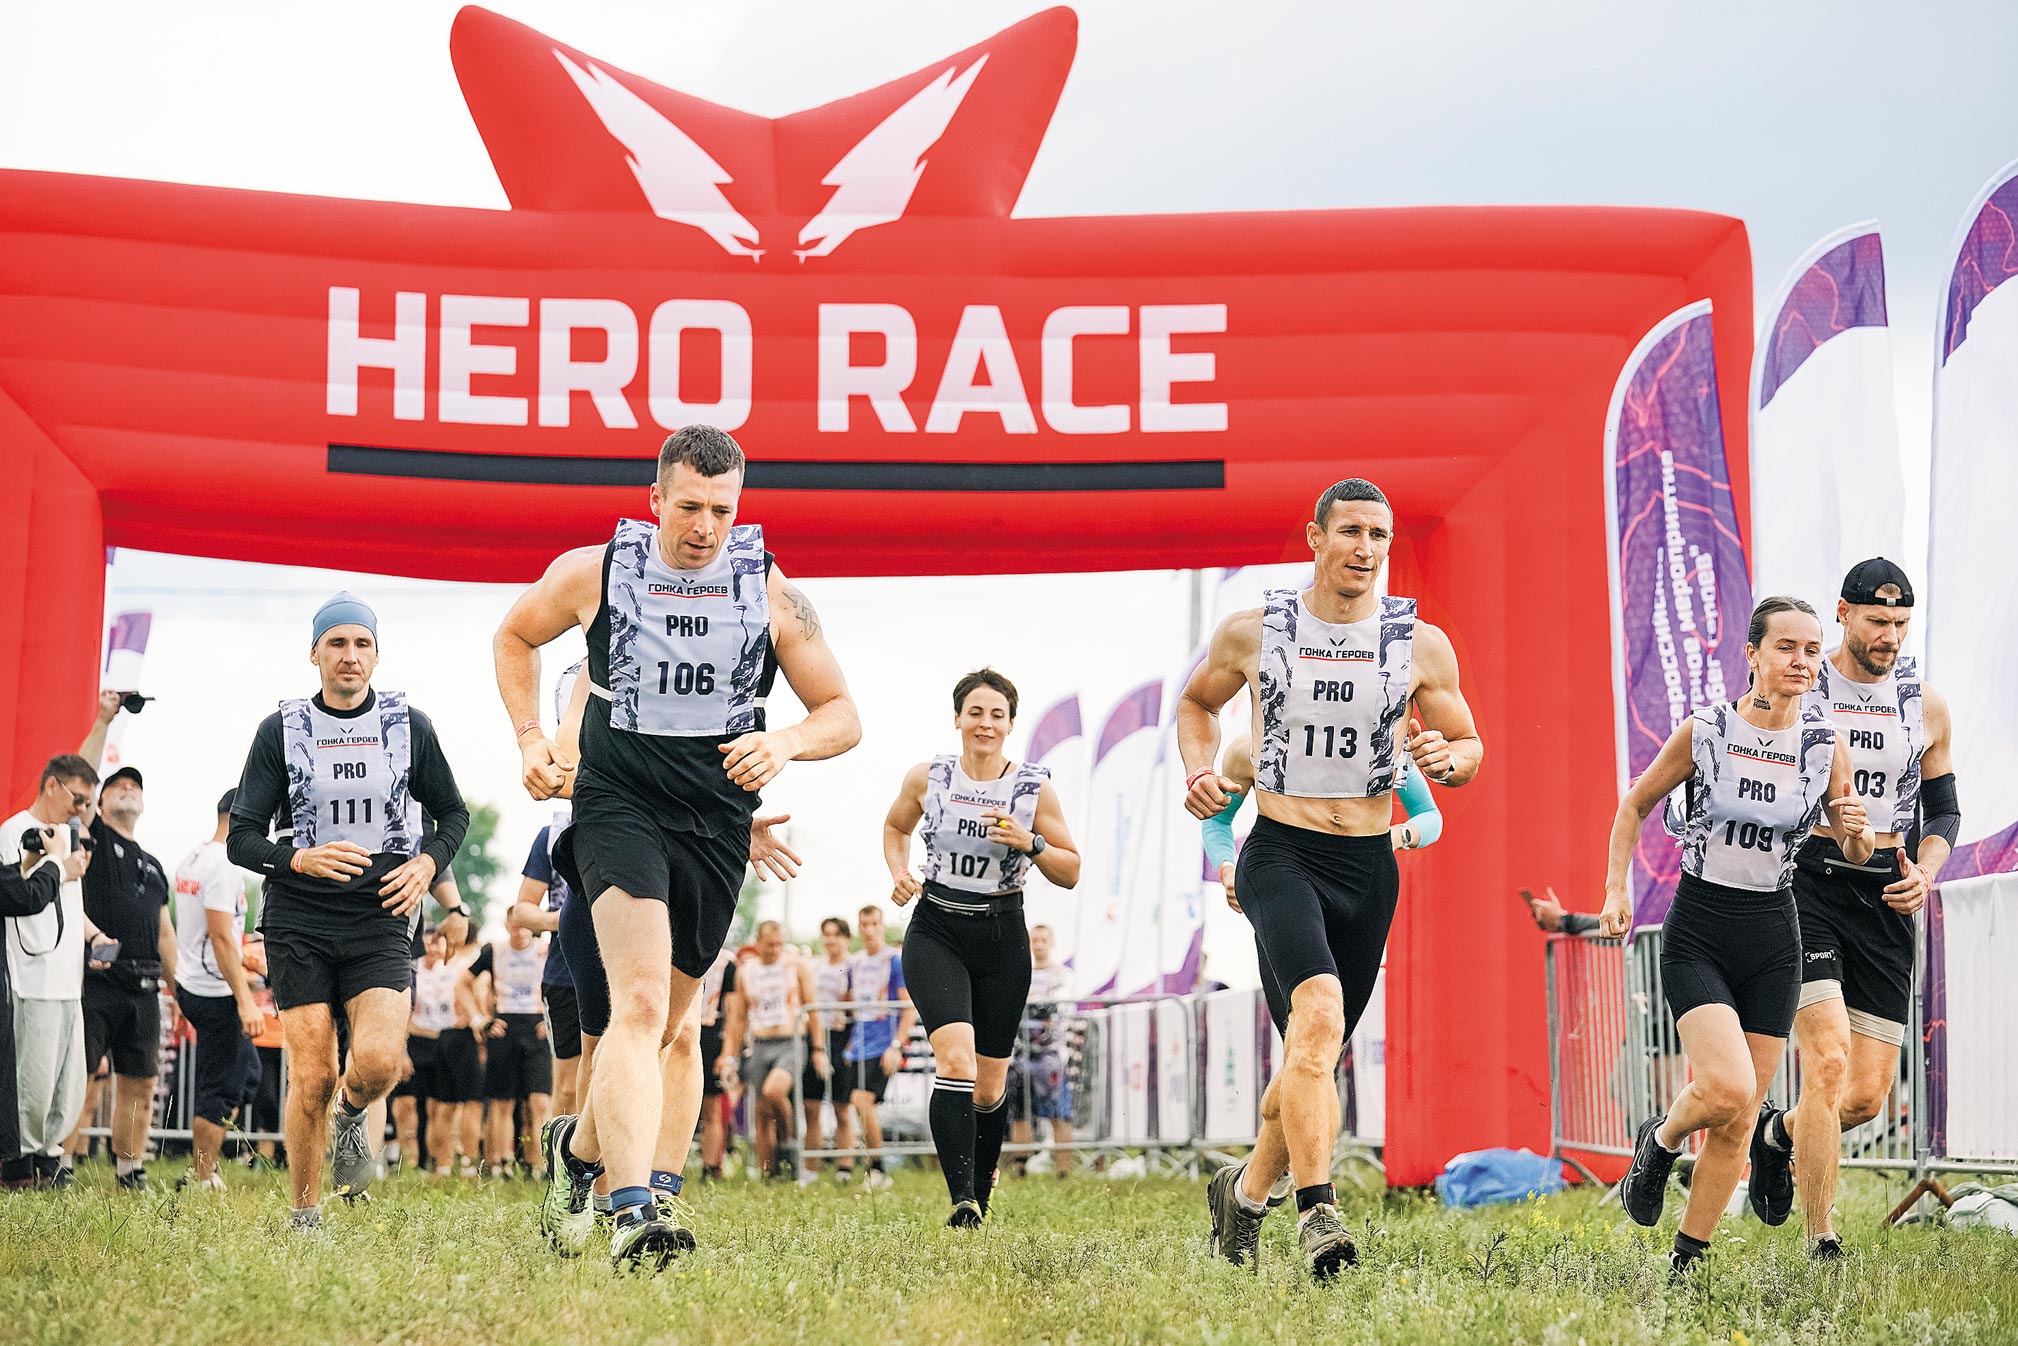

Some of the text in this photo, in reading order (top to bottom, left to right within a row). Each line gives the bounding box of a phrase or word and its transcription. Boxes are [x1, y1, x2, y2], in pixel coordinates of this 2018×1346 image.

[327, 286, 1229, 434] HERO RACE
[647, 583, 728, 595] ГОНКА ГЕРОЕВ
[666, 614, 709, 637] PRO
[1652, 546, 1687, 735] сероссийское
[1299, 647, 1375, 659] ГОНКА ГЕРОЕВ
[657, 661, 715, 695] 106
[1313, 680, 1354, 702] PRO
[1833, 702, 1897, 714] ГОНКА ГЕРОЕВ
[316, 736, 378, 746] ГОНКА ГЕРОЕВ
[1304, 725, 1358, 758] 113
[1849, 729, 1884, 750] PRO
[1727, 743, 1796, 763] ГОНКА ГЕРОЕВ
[333, 761, 367, 780] PRO
[1738, 777, 1776, 803] PRO
[1853, 769, 1887, 798] 03
[950, 793, 1007, 806] ГОНКА ГЕРОЕВ
[330, 798, 372, 824] 111
[957, 818, 988, 838] PRO
[1724, 820, 1775, 852] 109
[950, 852, 990, 878] 107
